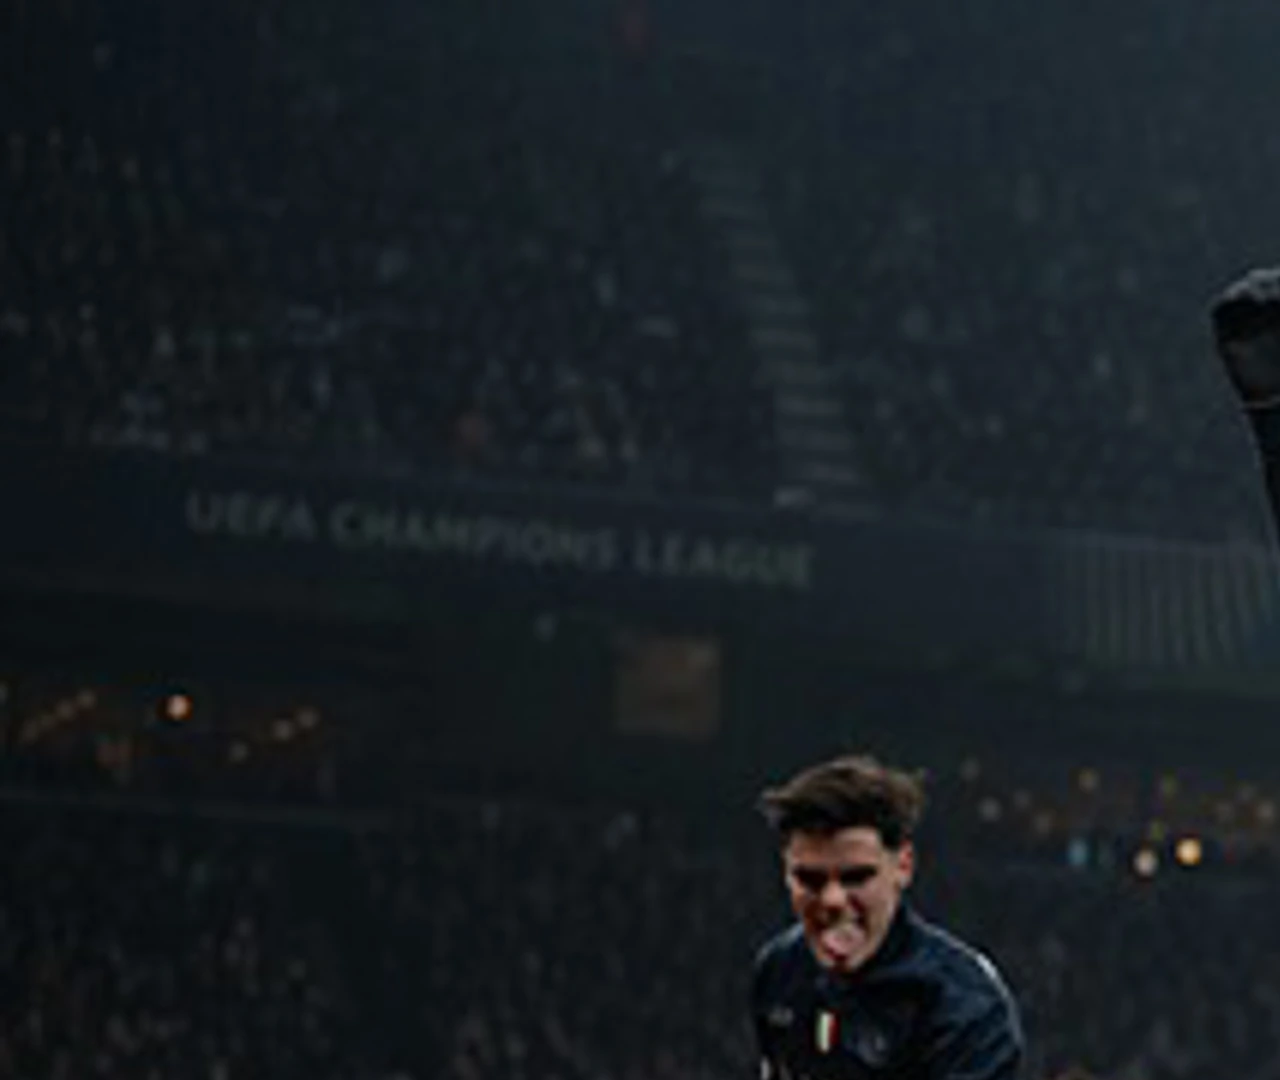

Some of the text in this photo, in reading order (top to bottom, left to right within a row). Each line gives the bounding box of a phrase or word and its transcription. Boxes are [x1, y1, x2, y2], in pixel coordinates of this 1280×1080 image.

[185, 489, 816, 592] UEFA CHAMPIONS LEAGUE
